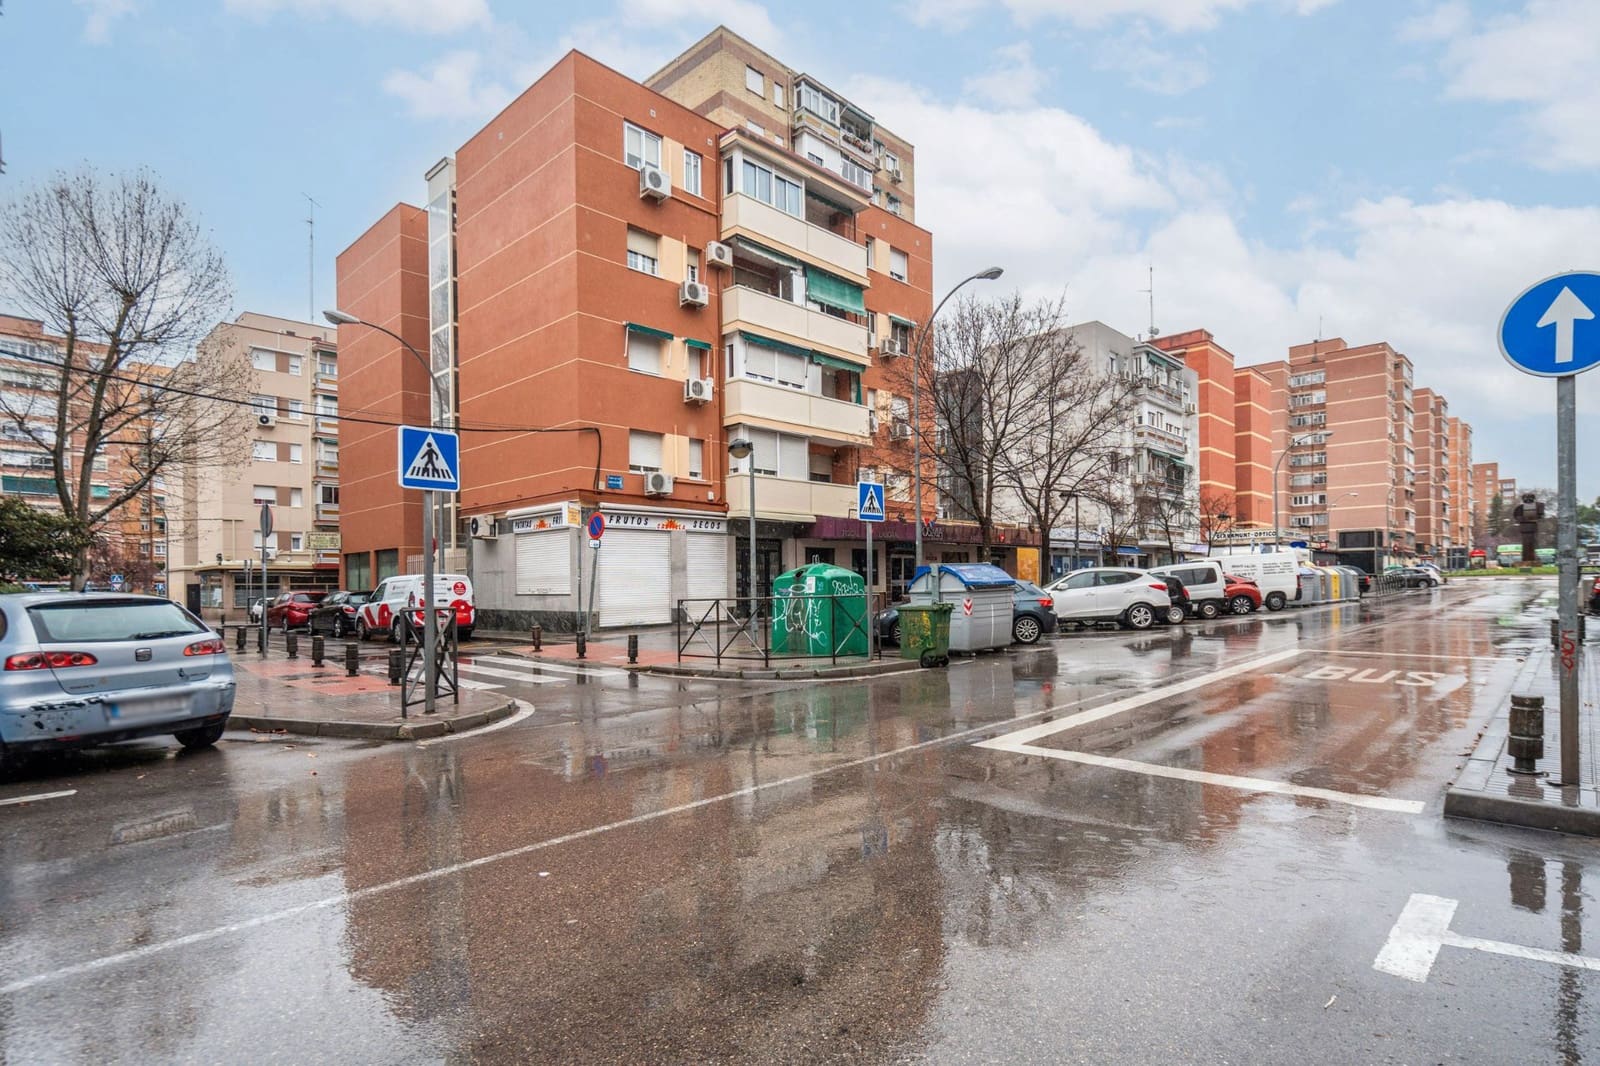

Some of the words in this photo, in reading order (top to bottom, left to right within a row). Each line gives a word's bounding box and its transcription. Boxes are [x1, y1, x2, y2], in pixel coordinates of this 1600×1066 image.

[609, 515, 649, 526] FRUTOS
[693, 520, 721, 530] SECOS
[1302, 665, 1446, 686] BUS
